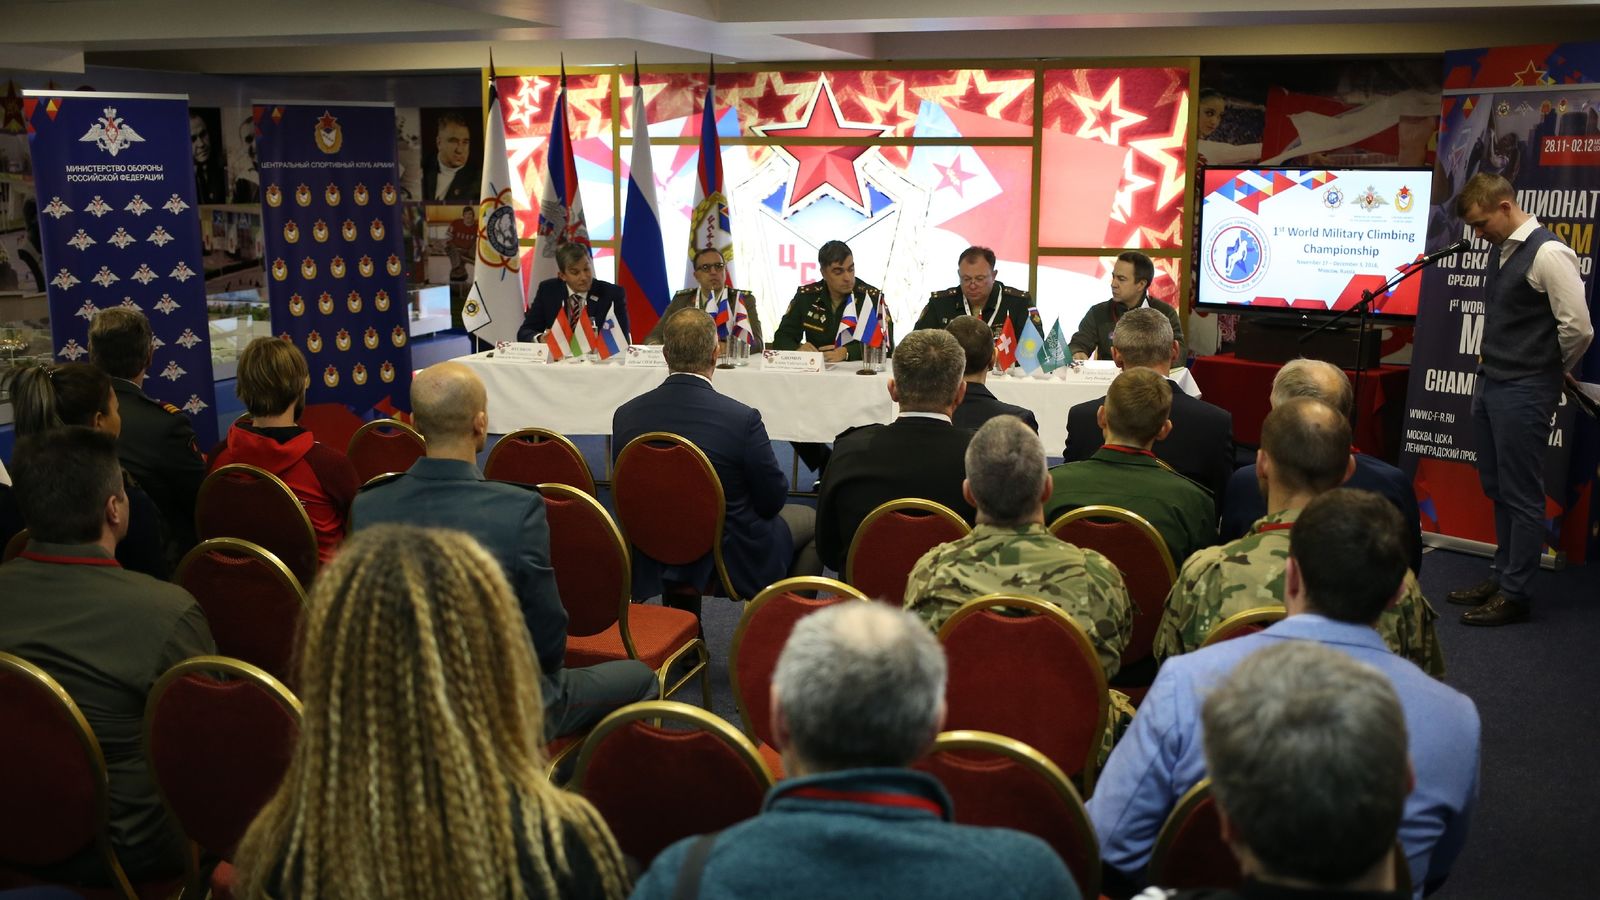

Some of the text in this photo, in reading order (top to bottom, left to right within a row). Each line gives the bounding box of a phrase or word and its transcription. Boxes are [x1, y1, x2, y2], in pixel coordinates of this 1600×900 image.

[1571, 138, 1594, 152] 02.12
[65, 164, 164, 173] МИНИСТЕРСТВО ОБОРОНЫ
[261, 160, 395, 169] ЦЕНТРАЛЬНЫЙ СПОРТИВНЫЙ КЛУБ АРМИИ
[67, 172, 164, 182] РОССИЙСКОЙ ФЕДЕРАЦИИ
[1273, 226, 1416, 243] 1st World Military Climbing
[1303, 243, 1380, 258] Championship
[1447, 274, 1480, 288] СРЕДИ
[1425, 368, 1478, 396] CHAM
[1409, 409, 1456, 423] WWW.C-F-R.RU
[1434, 433, 1453, 445] ЦСКА
[1404, 442, 1478, 461] ЛЕНИНГРАДСКИЙ ПРОС
